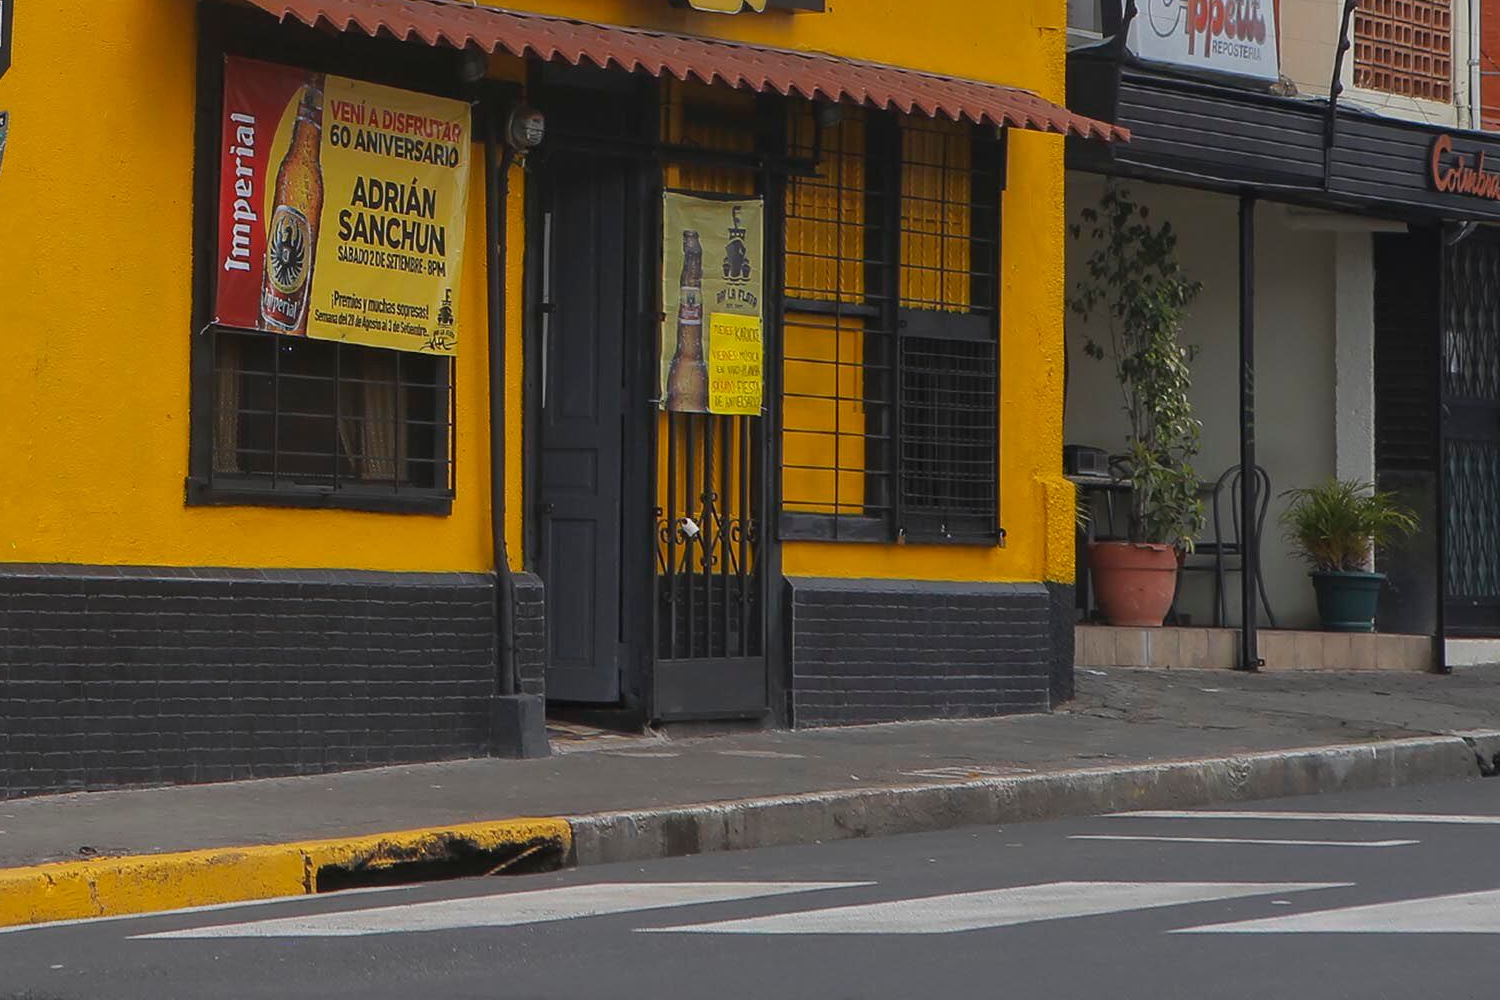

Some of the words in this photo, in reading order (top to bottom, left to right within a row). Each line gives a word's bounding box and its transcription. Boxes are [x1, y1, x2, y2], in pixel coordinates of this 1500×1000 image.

[331, 100, 366, 126] VENÍ
[368, 108, 380, 129] A
[382, 110, 462, 144] DISFRUTAR
[329, 124, 352, 149] 60
[354, 129, 459, 168] ANIVERSARIO
[223, 111, 258, 273] Imperial
[350, 176, 437, 220] ADRIÁN
[337, 209, 446, 257] SANCHUN
[337, 243, 369, 266] SÁBADO
[369, 251, 375, 267] 2
[376, 252, 386, 269] DE
[386, 253, 423, 274] SETIEMBRE
[428, 260, 447, 278] 8PM
